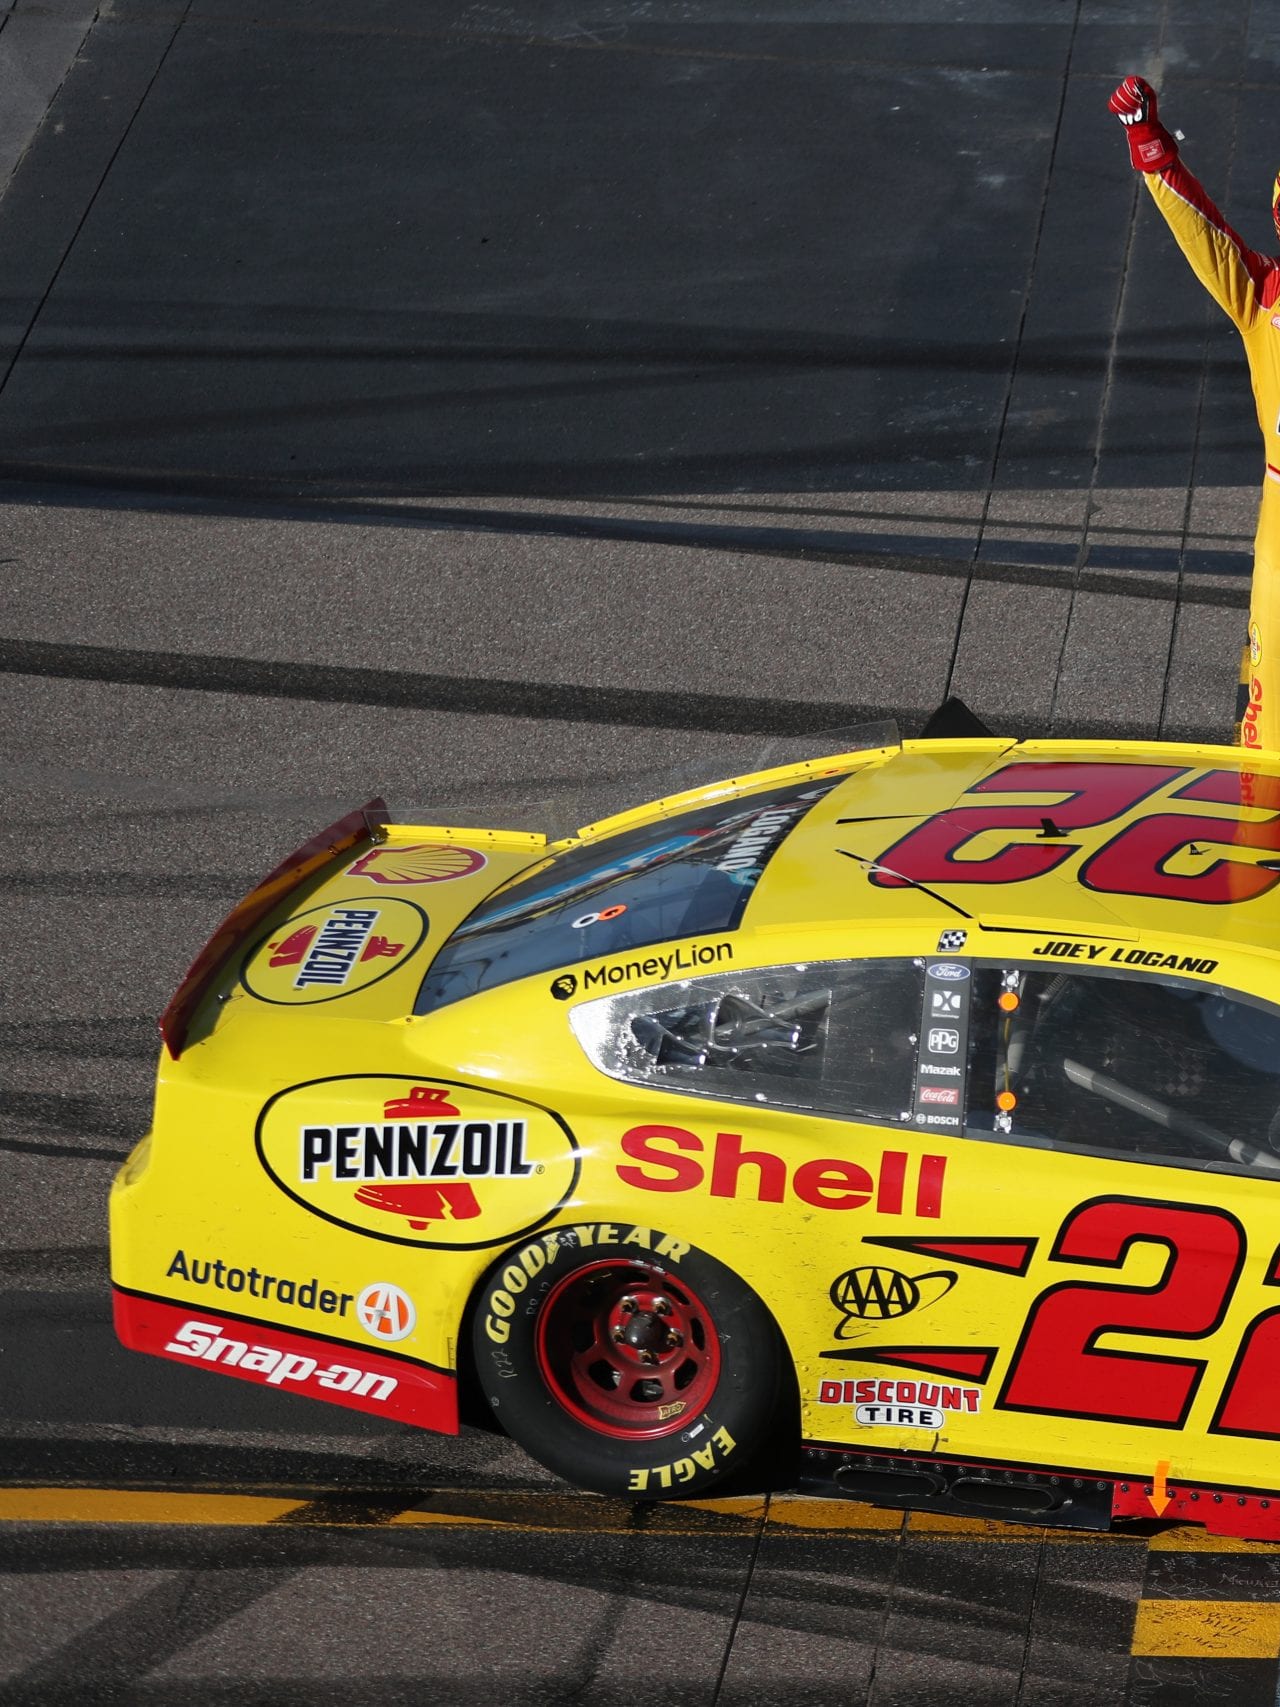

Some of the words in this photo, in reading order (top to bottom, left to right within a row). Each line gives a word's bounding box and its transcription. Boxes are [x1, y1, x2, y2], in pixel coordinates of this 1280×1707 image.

[716, 807, 799, 871] LOGANO
[296, 909, 379, 987] PENNZOIL
[584, 942, 734, 991] MoneyLion
[935, 966, 962, 978] Ford
[1033, 941, 1107, 960] JOEY
[1110, 948, 1219, 974] LOGANO
[930, 1031, 957, 1051] PPG
[920, 1064, 961, 1076] Mazak
[927, 1115, 960, 1126] BOSCH
[303, 1122, 533, 1180] PENNZOIL
[616, 1124, 948, 1219] Shell
[167, 1249, 355, 1317] Autotrader
[839, 1267, 913, 1318] AAA
[165, 1321, 398, 1401] Snap-on
[820, 1381, 980, 1412] DISCOUNT
[865, 1407, 934, 1425] TIRE
[628, 1425, 737, 1492] EAGLE
